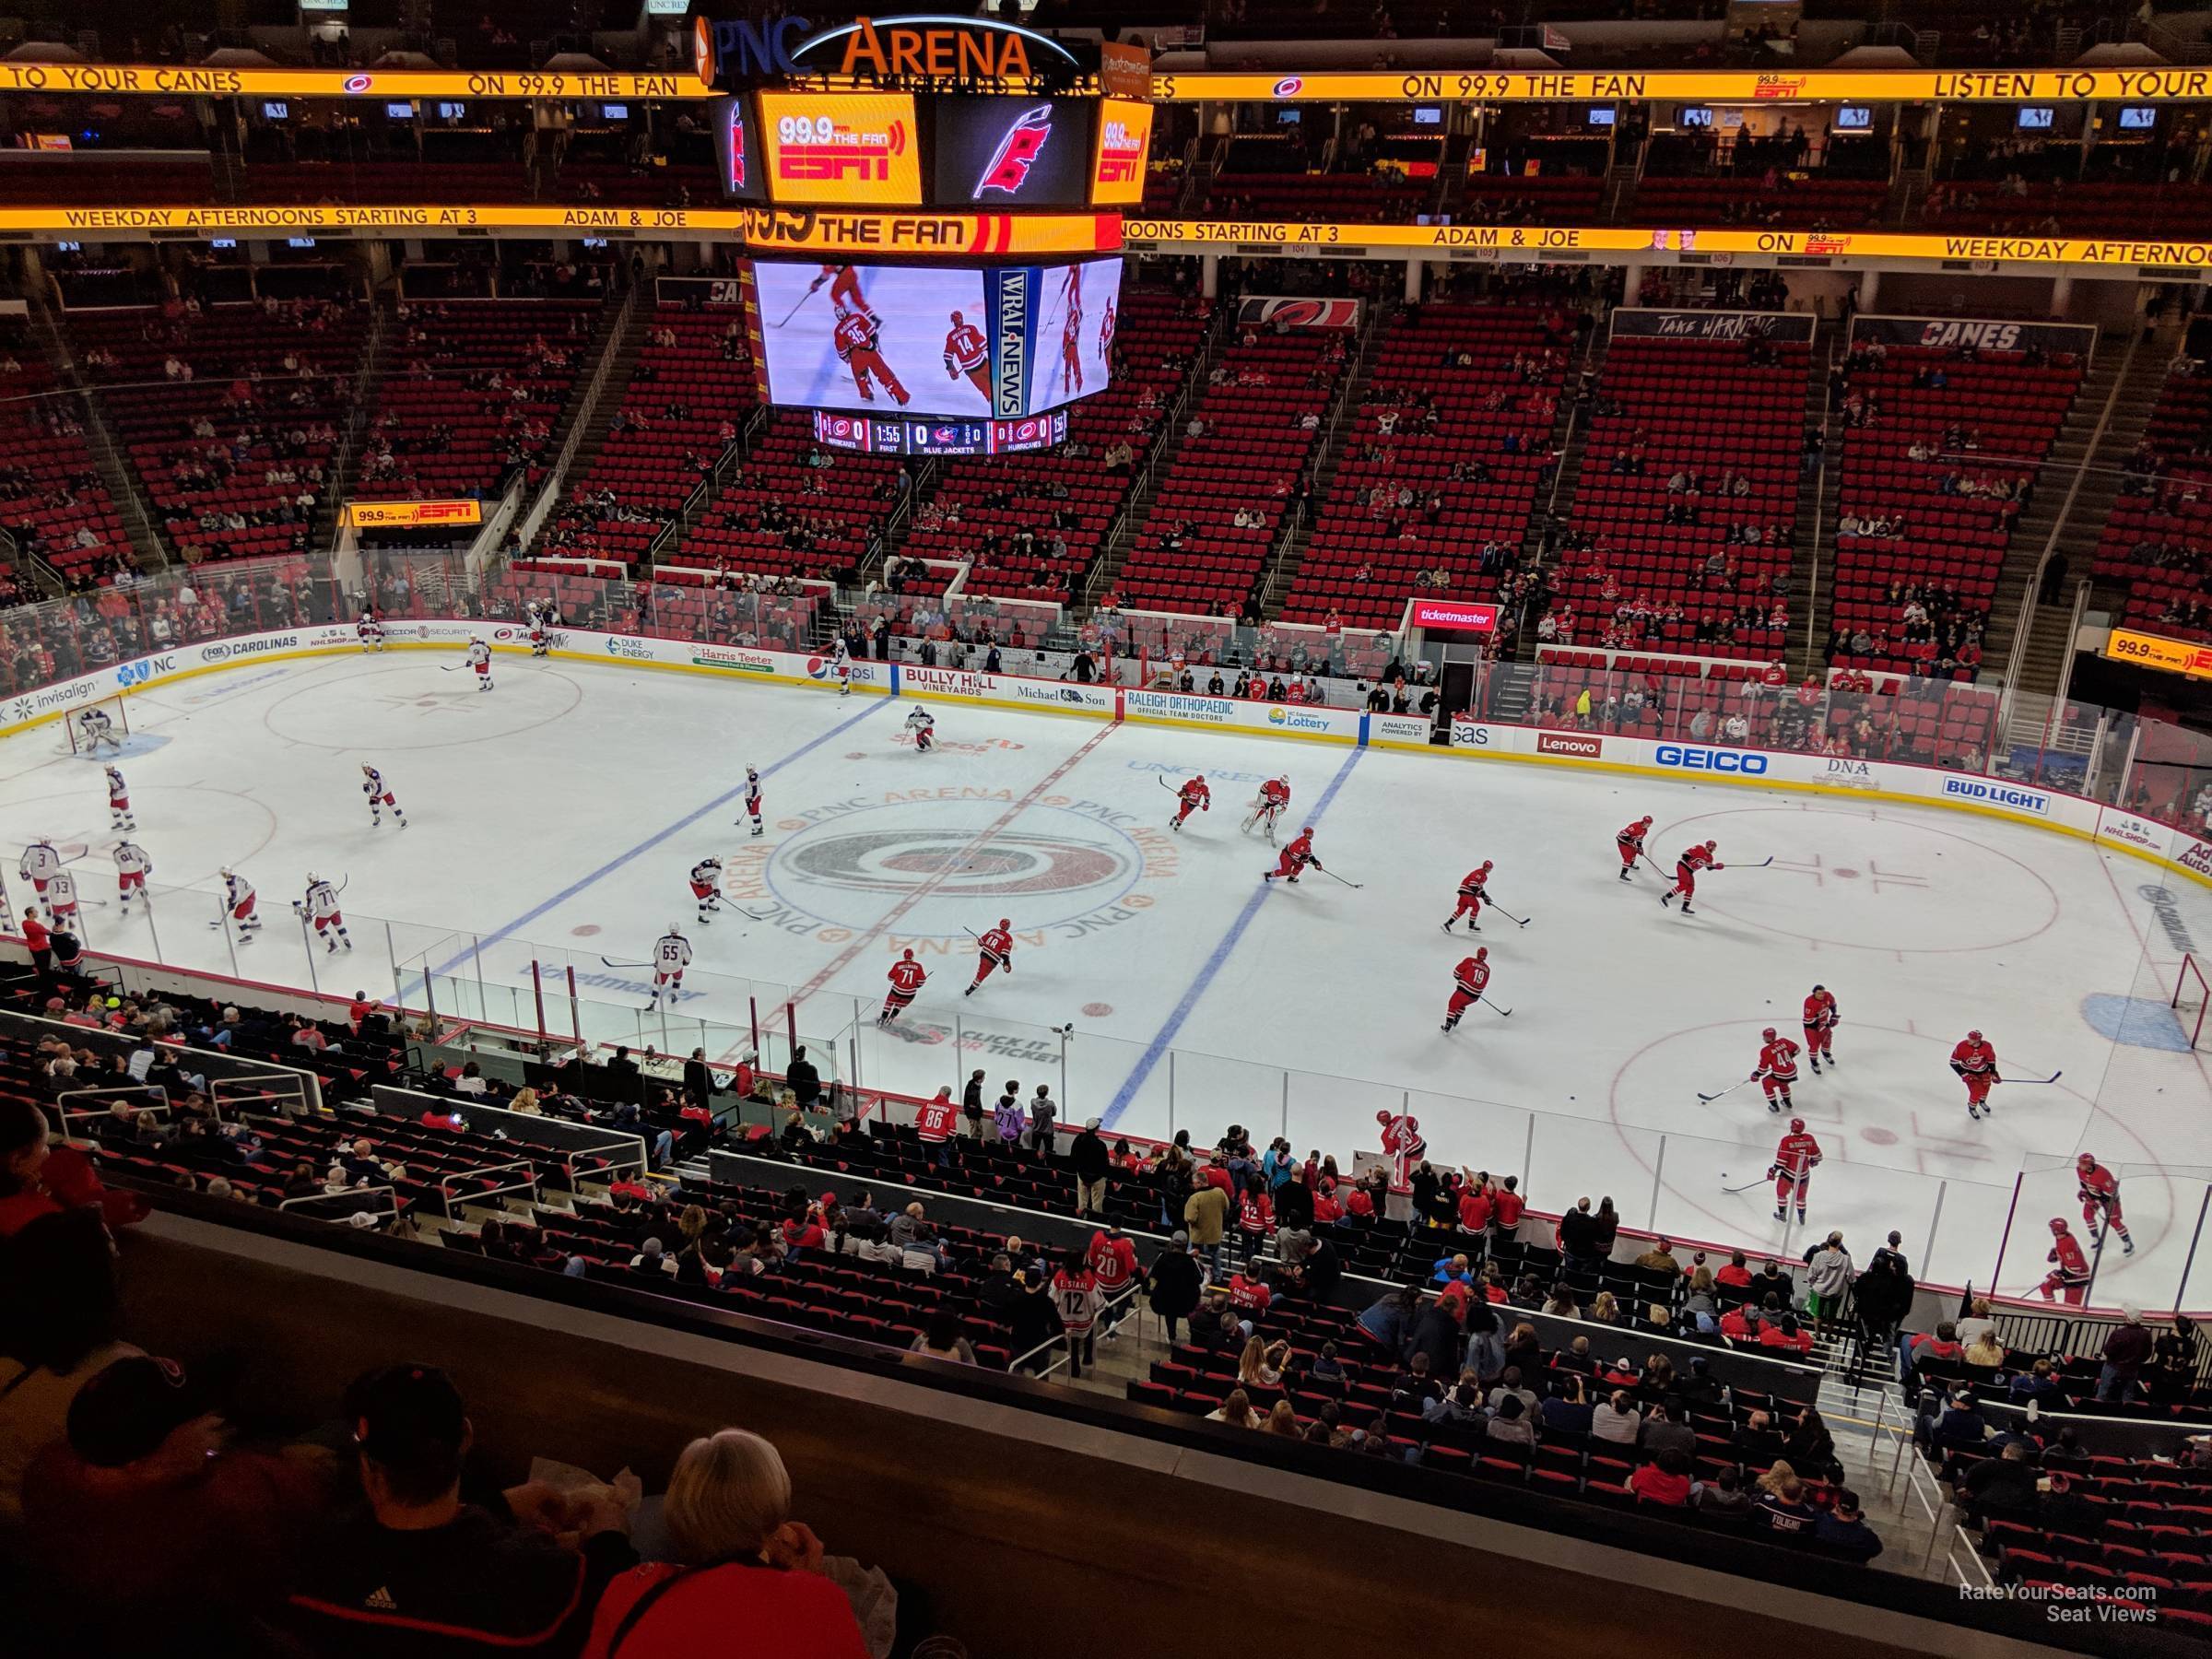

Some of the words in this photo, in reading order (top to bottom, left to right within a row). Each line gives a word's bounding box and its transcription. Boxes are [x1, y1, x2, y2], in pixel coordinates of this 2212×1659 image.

[713, 16, 813, 76] PNC
[841, 16, 1032, 76] ARENA
[10, 66, 47, 90] TO
[62, 67, 141, 92] YOUR
[155, 70, 242, 93] CANES
[468, 75, 506, 97] ON
[518, 75, 565, 96] 99.9
[577, 76, 620, 96] THE
[634, 76, 678, 97] FAN
[1403, 76, 1441, 98] ON
[1457, 76, 1510, 97] 99.9
[1526, 76, 1574, 97] THE
[1592, 76, 1645, 97] FAN
[1935, 74, 2034, 98] LISTEN
[2055, 73, 2097, 97] TO
[2118, 73, 2207, 97] YOUR
[779, 115, 834, 144] 99.9
[833, 134, 859, 144] THE
[861, 133, 888, 145] FAN
[780, 145, 888, 181] ESPN
[1098, 149, 1139, 182] ESPN
[66, 210, 172, 228] WEEKDAY
[186, 209, 324, 226] AFTERNOONS
[335, 209, 428, 225] STARTING
[440, 209, 461, 224] AT
[466, 210, 477, 224] 3
[563, 210, 618, 227] ADAM
[630, 211, 642, 226] &
[653, 211, 687, 227] JOE
[818, 218, 880, 243] THE
[891, 218, 964, 244] FAN
[1195, 224, 1287, 241] STARTING
[1298, 227, 1325, 241] AT
[1327, 227, 1338, 242] 3
[1434, 229, 1499, 246] ADAM
[1512, 230, 1526, 245] &
[1537, 230, 1579, 247] JOE
[1758, 234, 1794, 252] ON
[1947, 240, 2069, 261] WEEKDAY
[1003, 273, 1025, 337] WRAL
[847, 327, 866, 345] 35
[1921, 321, 2021, 349] CANES
[957, 335, 974, 354] 14
[1002, 341, 1020, 414] NEWS
[853, 420, 864, 441] 0
[877, 426, 900, 443] 1:55
[915, 425, 928, 445] 0
[973, 429, 981, 441] 0
[1039, 419, 1047, 438] 0
[924, 446, 942, 454] BLUE
[943, 446, 975, 454] JACKETS
[359, 511, 384, 522] 99.9
[418, 503, 471, 519] ESPN
[1420, 609, 1489, 625] ticketmaster
[207, 647, 225, 657] FOX
[233, 636, 298, 655] CAROLINAS
[621, 639, 642, 649] DUKE
[2116, 640, 2149, 657] 99.9
[622, 648, 653, 660] ENERGY
[701, 648, 735, 661] Harris
[738, 653, 772, 665] Teeter
[155, 656, 176, 674] NC
[906, 668, 956, 686] BULLY
[37, 681, 96, 709] invisalign
[922, 683, 982, 697] VINEYARDS
[1018, 686, 1059, 701] Michael
[1086, 694, 1105, 706] Son
[1128, 692, 1167, 708] RALEIGH
[1170, 696, 1233, 715] ORTHOPAEDIC
[1137, 707, 1167, 716] OFFICIAL
[1170, 710, 1188, 718] TEAM
[1191, 712, 1223, 722] DOCTORS
[1288, 716, 1330, 732] Lottery
[1381, 728, 1413, 736] POWERED
[1382, 722, 1423, 732] ANALYTICS
[1542, 737, 1596, 753] Lenovo
[1127, 760, 1199, 776] UNC
[1655, 746, 1768, 775] GEICO
[1828, 759, 1871, 775] DNA
[799, 796, 876, 821] PNC
[884, 787, 1013, 804] ARENA
[1947, 780, 1987, 798] BUD
[1990, 787, 2046, 810] LIGHT
[1069, 800, 1137, 827] PNC
[39, 854, 45, 867] 3
[2177, 853, 2210, 874] Auto
[55, 881, 69, 894] 13
[664, 946, 678, 960] 65
[901, 969, 915, 984] 71
[1474, 969, 1485, 984] 19
[961, 1030, 1024, 1047] CLICK
[1025, 1041, 1051, 1051] IT
[952, 1039, 983, 1052] OR
[986, 1044, 1065, 1064] TICKET
[1778, 1053, 1794, 1066] 44
[924, 1111, 943, 1129] 86
[996, 1112, 1012, 1128] 27
[1097, 1254, 1117, 1277] 20
[1060, 1279, 1066, 1288] E.
[1068, 1280, 1088, 1290] STAAL
[1065, 1291, 1084, 1314] 12
[1771, 1514, 1801, 1530] FOLIGNO
